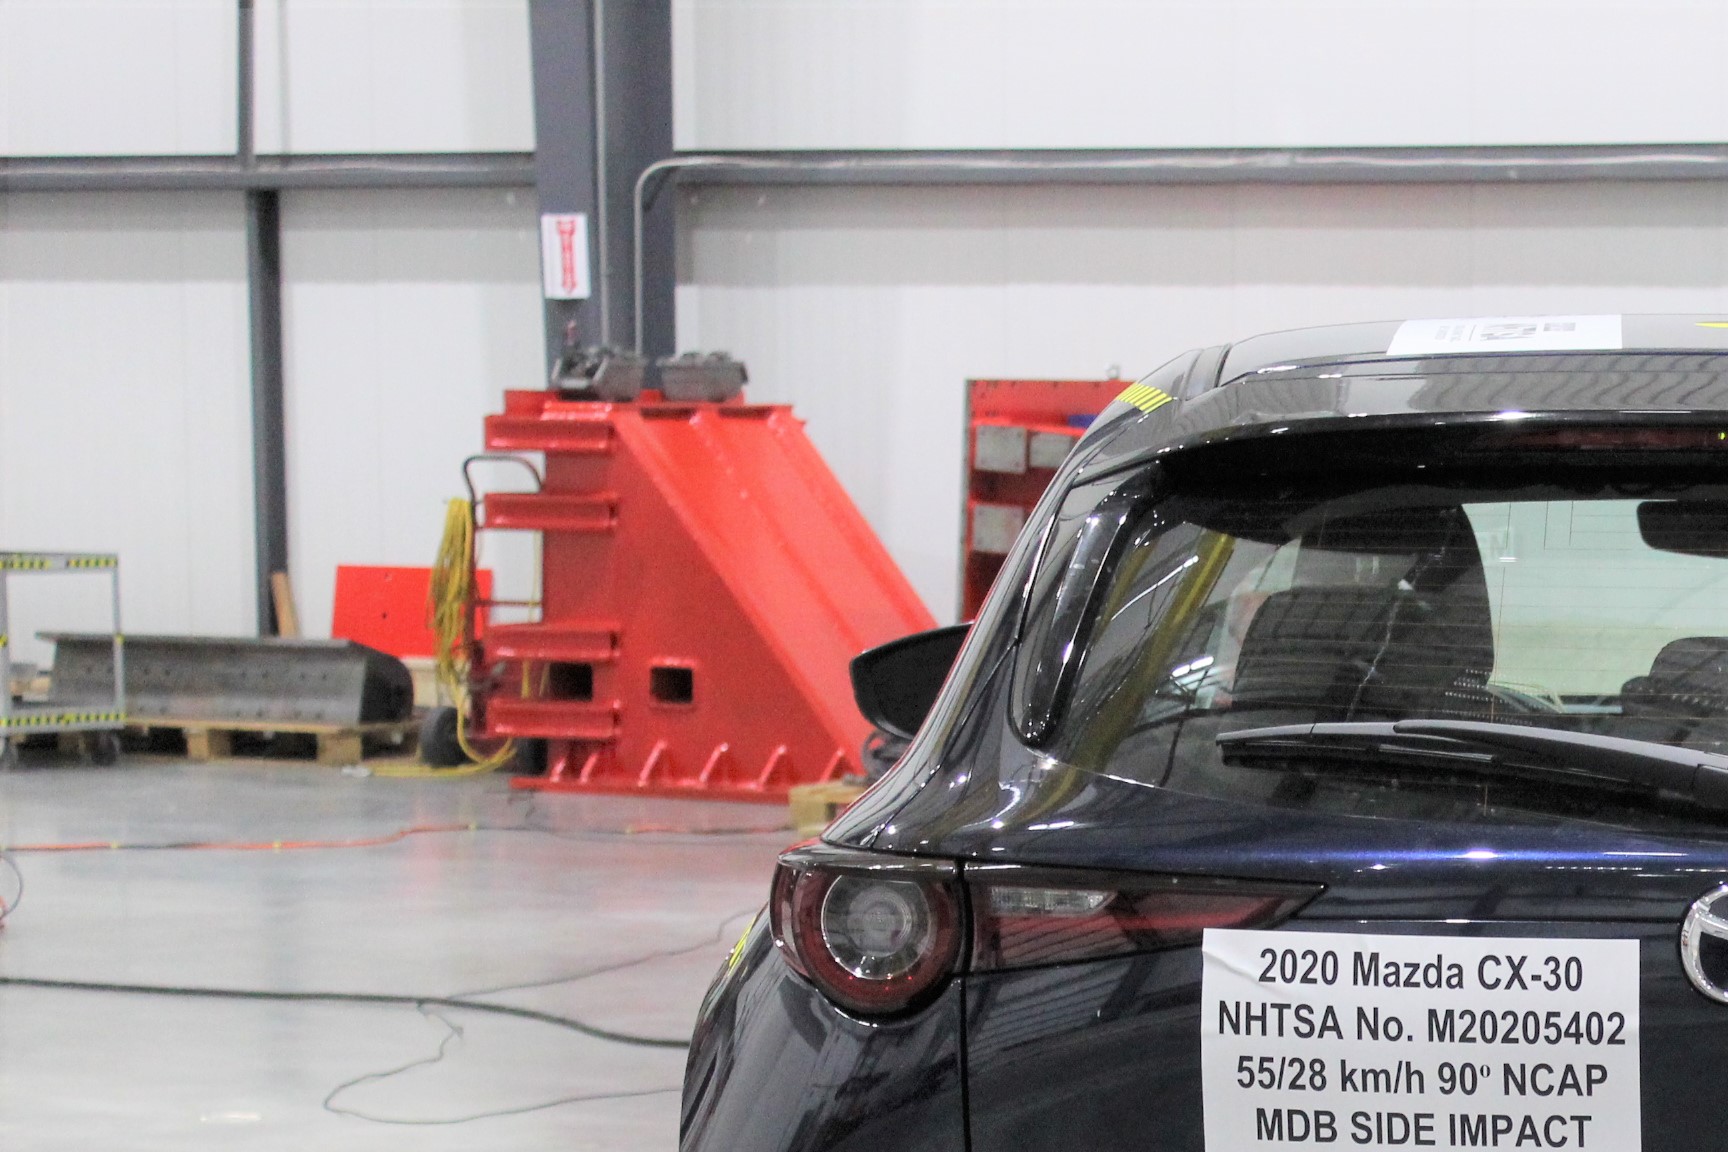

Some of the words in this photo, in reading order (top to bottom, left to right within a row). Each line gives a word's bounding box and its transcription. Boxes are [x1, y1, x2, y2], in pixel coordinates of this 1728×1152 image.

[1258, 948, 1339, 986] 2020
[1352, 952, 1464, 989] Mazda
[1477, 955, 1583, 992] CX-30
[1218, 1000, 1344, 1040] NHTSA
[1356, 1005, 1414, 1042] No.
[1427, 1009, 1626, 1046] M20205402
[1236, 1055, 1328, 1092] 55/28
[1339, 1059, 1425, 1095] km/h
[1503, 1063, 1609, 1097] NCAP
[1255, 1107, 1339, 1144] MDB
[1350, 1110, 1436, 1147] SIDE
[1449, 1113, 1592, 1148] IMPACT
